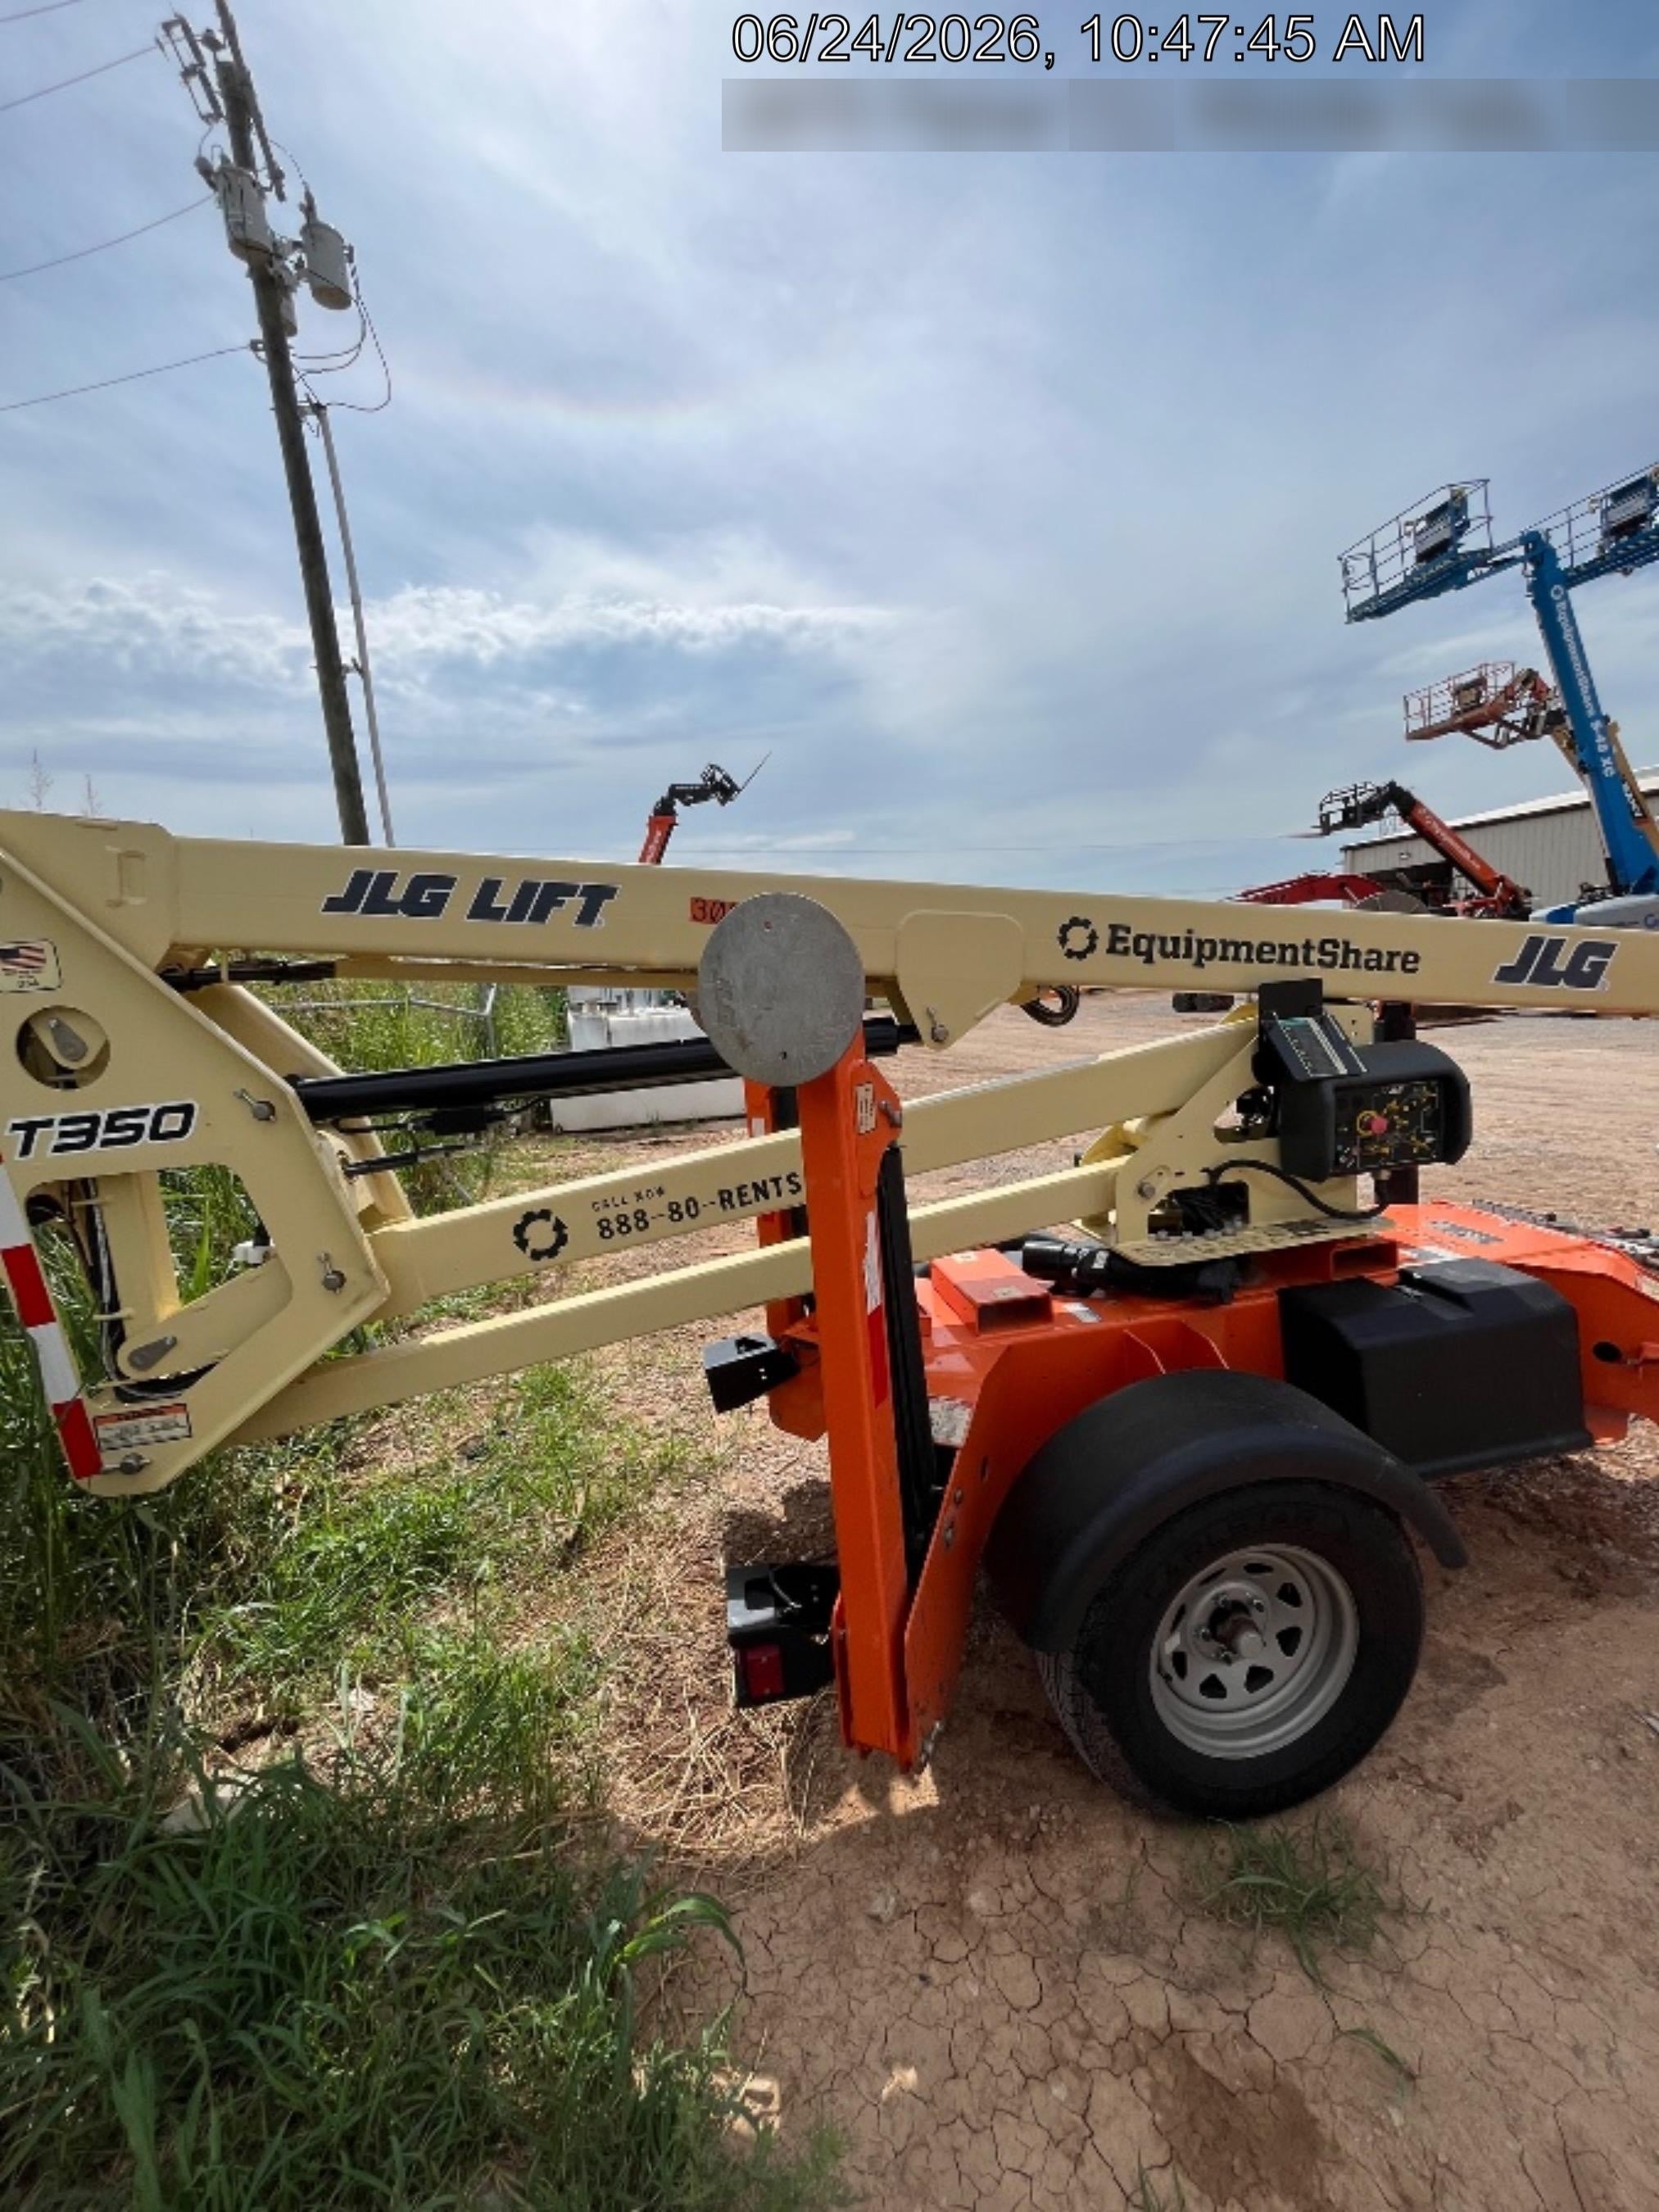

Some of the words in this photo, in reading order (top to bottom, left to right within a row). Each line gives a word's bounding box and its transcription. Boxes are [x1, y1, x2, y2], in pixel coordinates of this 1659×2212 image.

[321, 868, 459, 918] JLG
[465, 877, 623, 928] LIFT
[1106, 923, 1421, 974] EquipmentShare
[1491, 935, 1620, 990] JLG
[7, 1100, 197, 1160] T350
[591, 1197, 628, 1212] CALL
[596, 1172, 802, 1240] 888-80-RENTS
